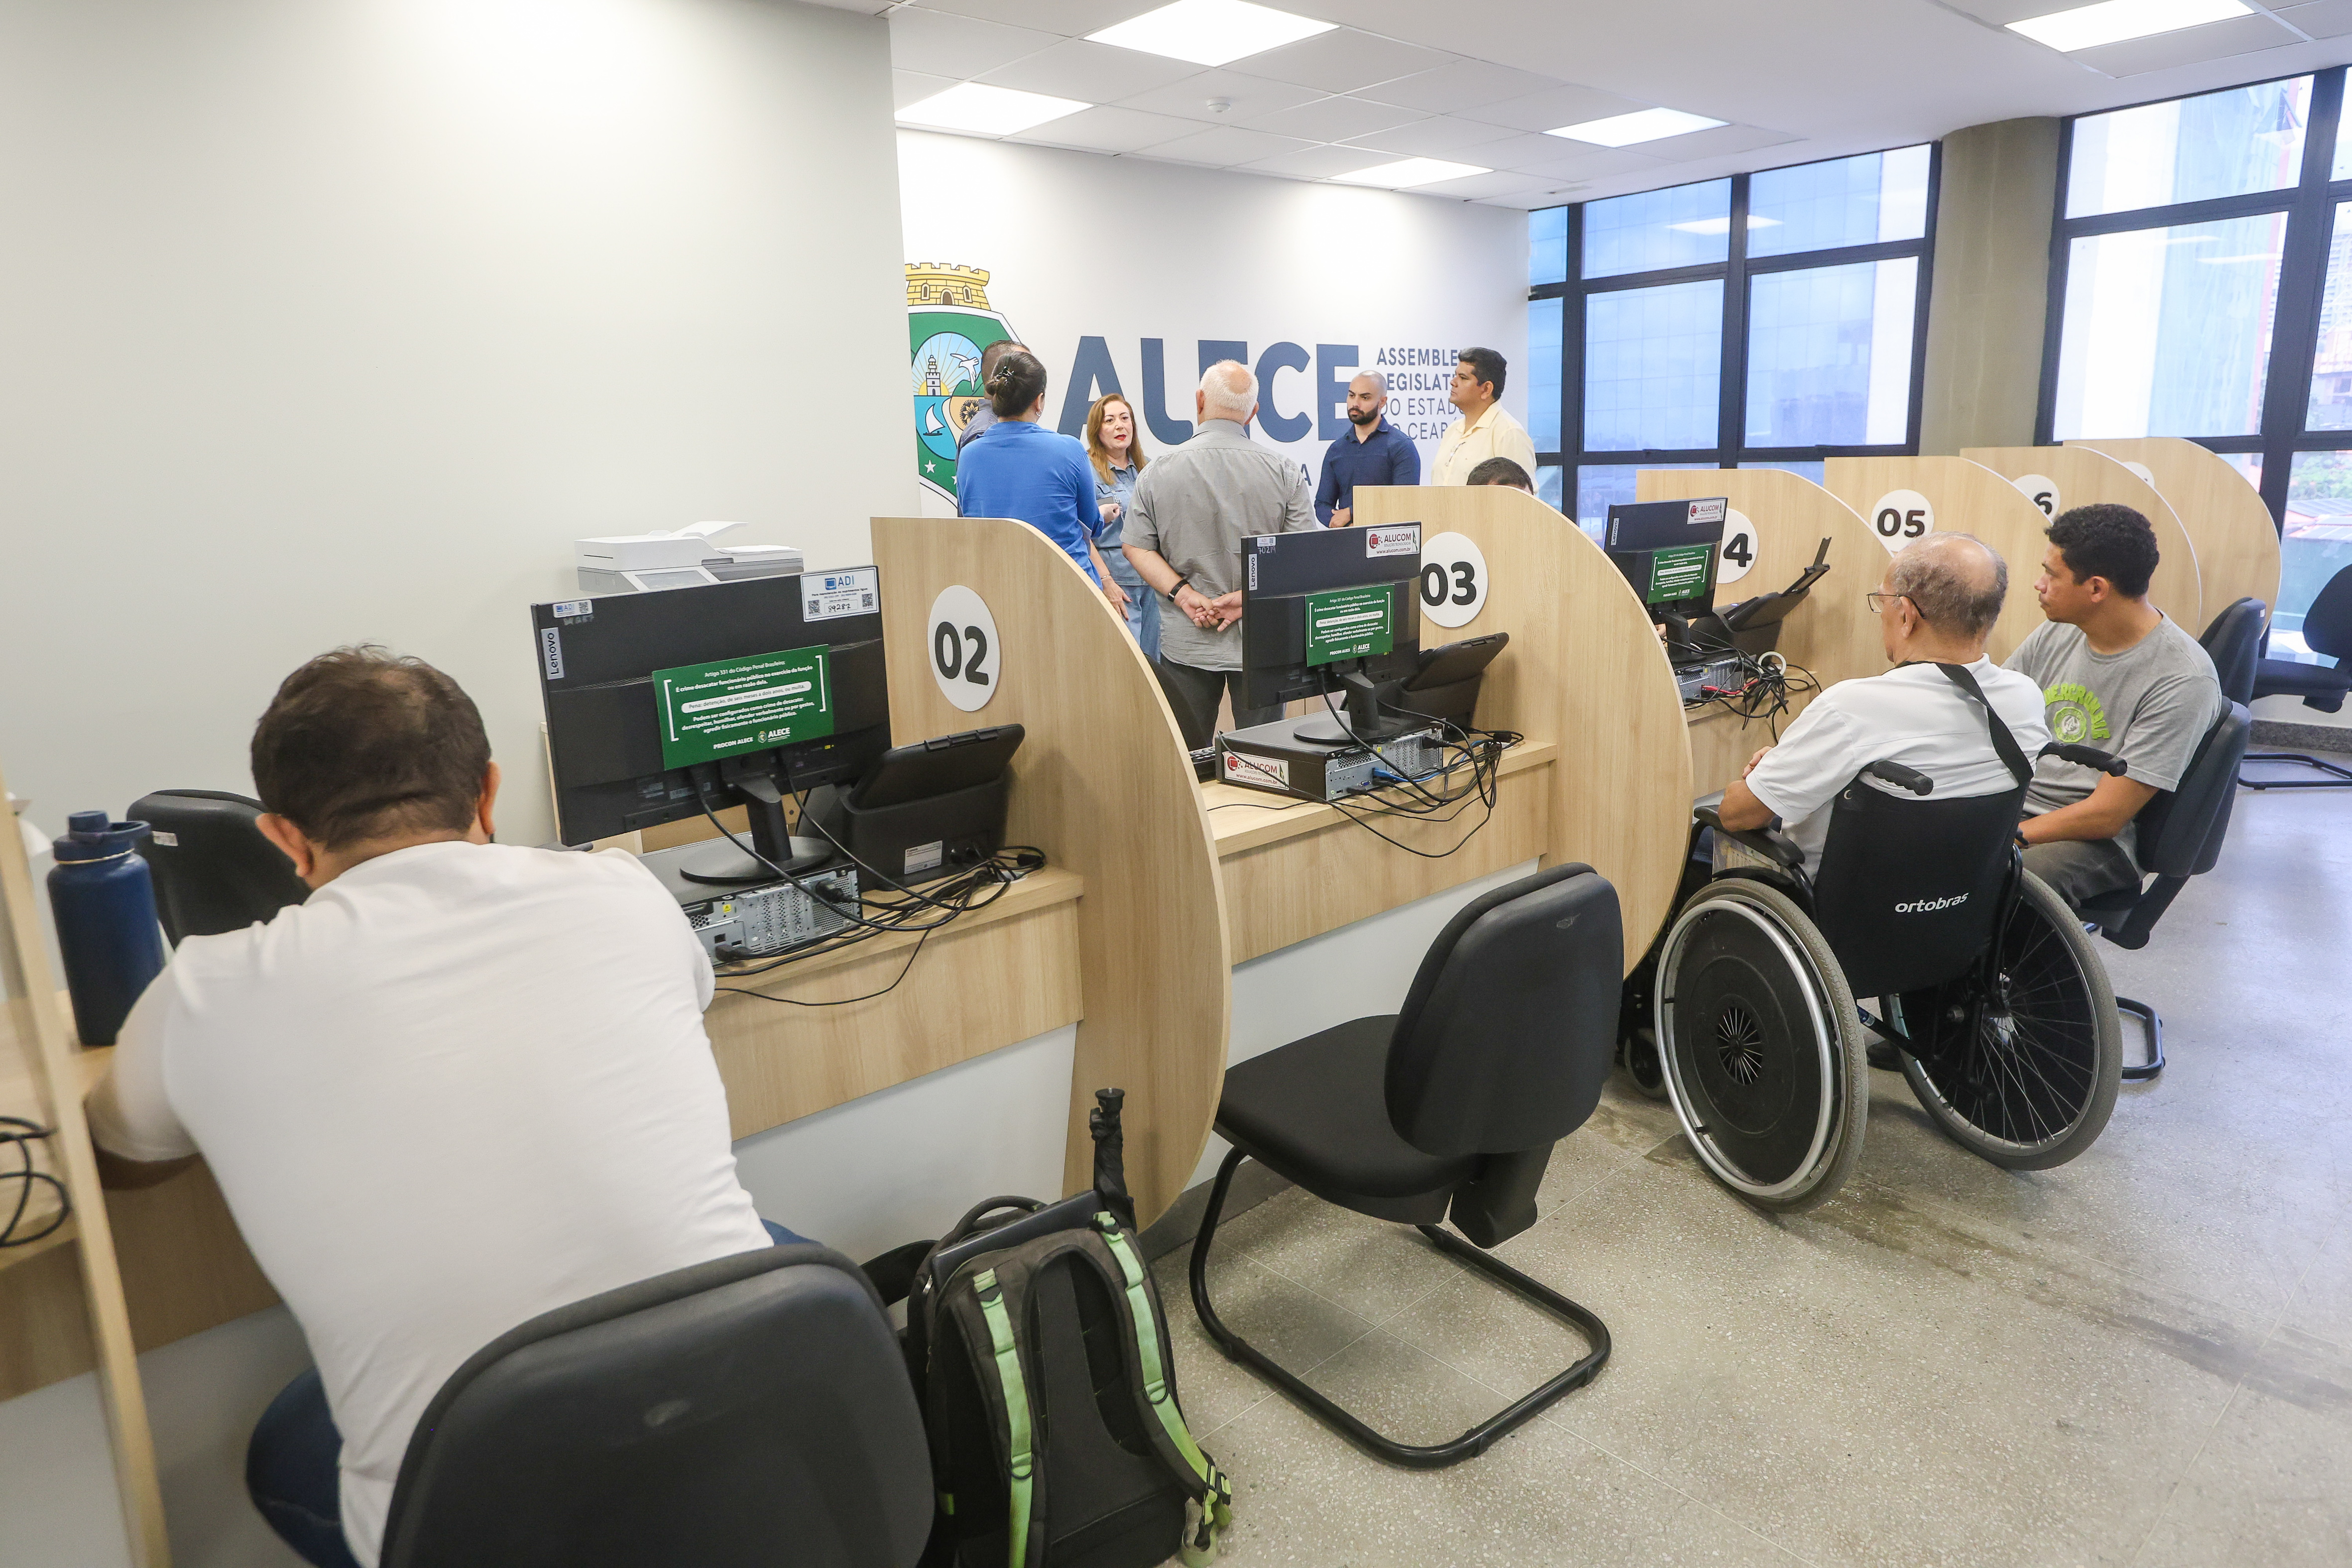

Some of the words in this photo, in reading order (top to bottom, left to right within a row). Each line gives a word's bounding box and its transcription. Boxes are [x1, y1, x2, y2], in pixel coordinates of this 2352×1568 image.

[1377, 347, 1458, 366] ASSEMBLE
[1387, 372, 1455, 391] EGISLAT
[1408, 398, 1464, 415] ESTAD
[1408, 418, 1456, 440] CEAR
[1877, 508, 1925, 538] 05
[1384, 533, 1411, 543] ALUCOM
[1723, 533, 1752, 567] 4
[837, 575, 854, 587] ADI
[1420, 561, 1477, 606] 03
[548, 632, 559, 675] Lenovo
[935, 621, 989, 686] 02
[768, 727, 791, 738] ALECE
[713, 740, 736, 749] PROCON
[737, 736, 754, 745] ALECE
[1236, 773, 1278, 785] www.alucom.com.br
[1895, 892, 1969, 913] ortobras
